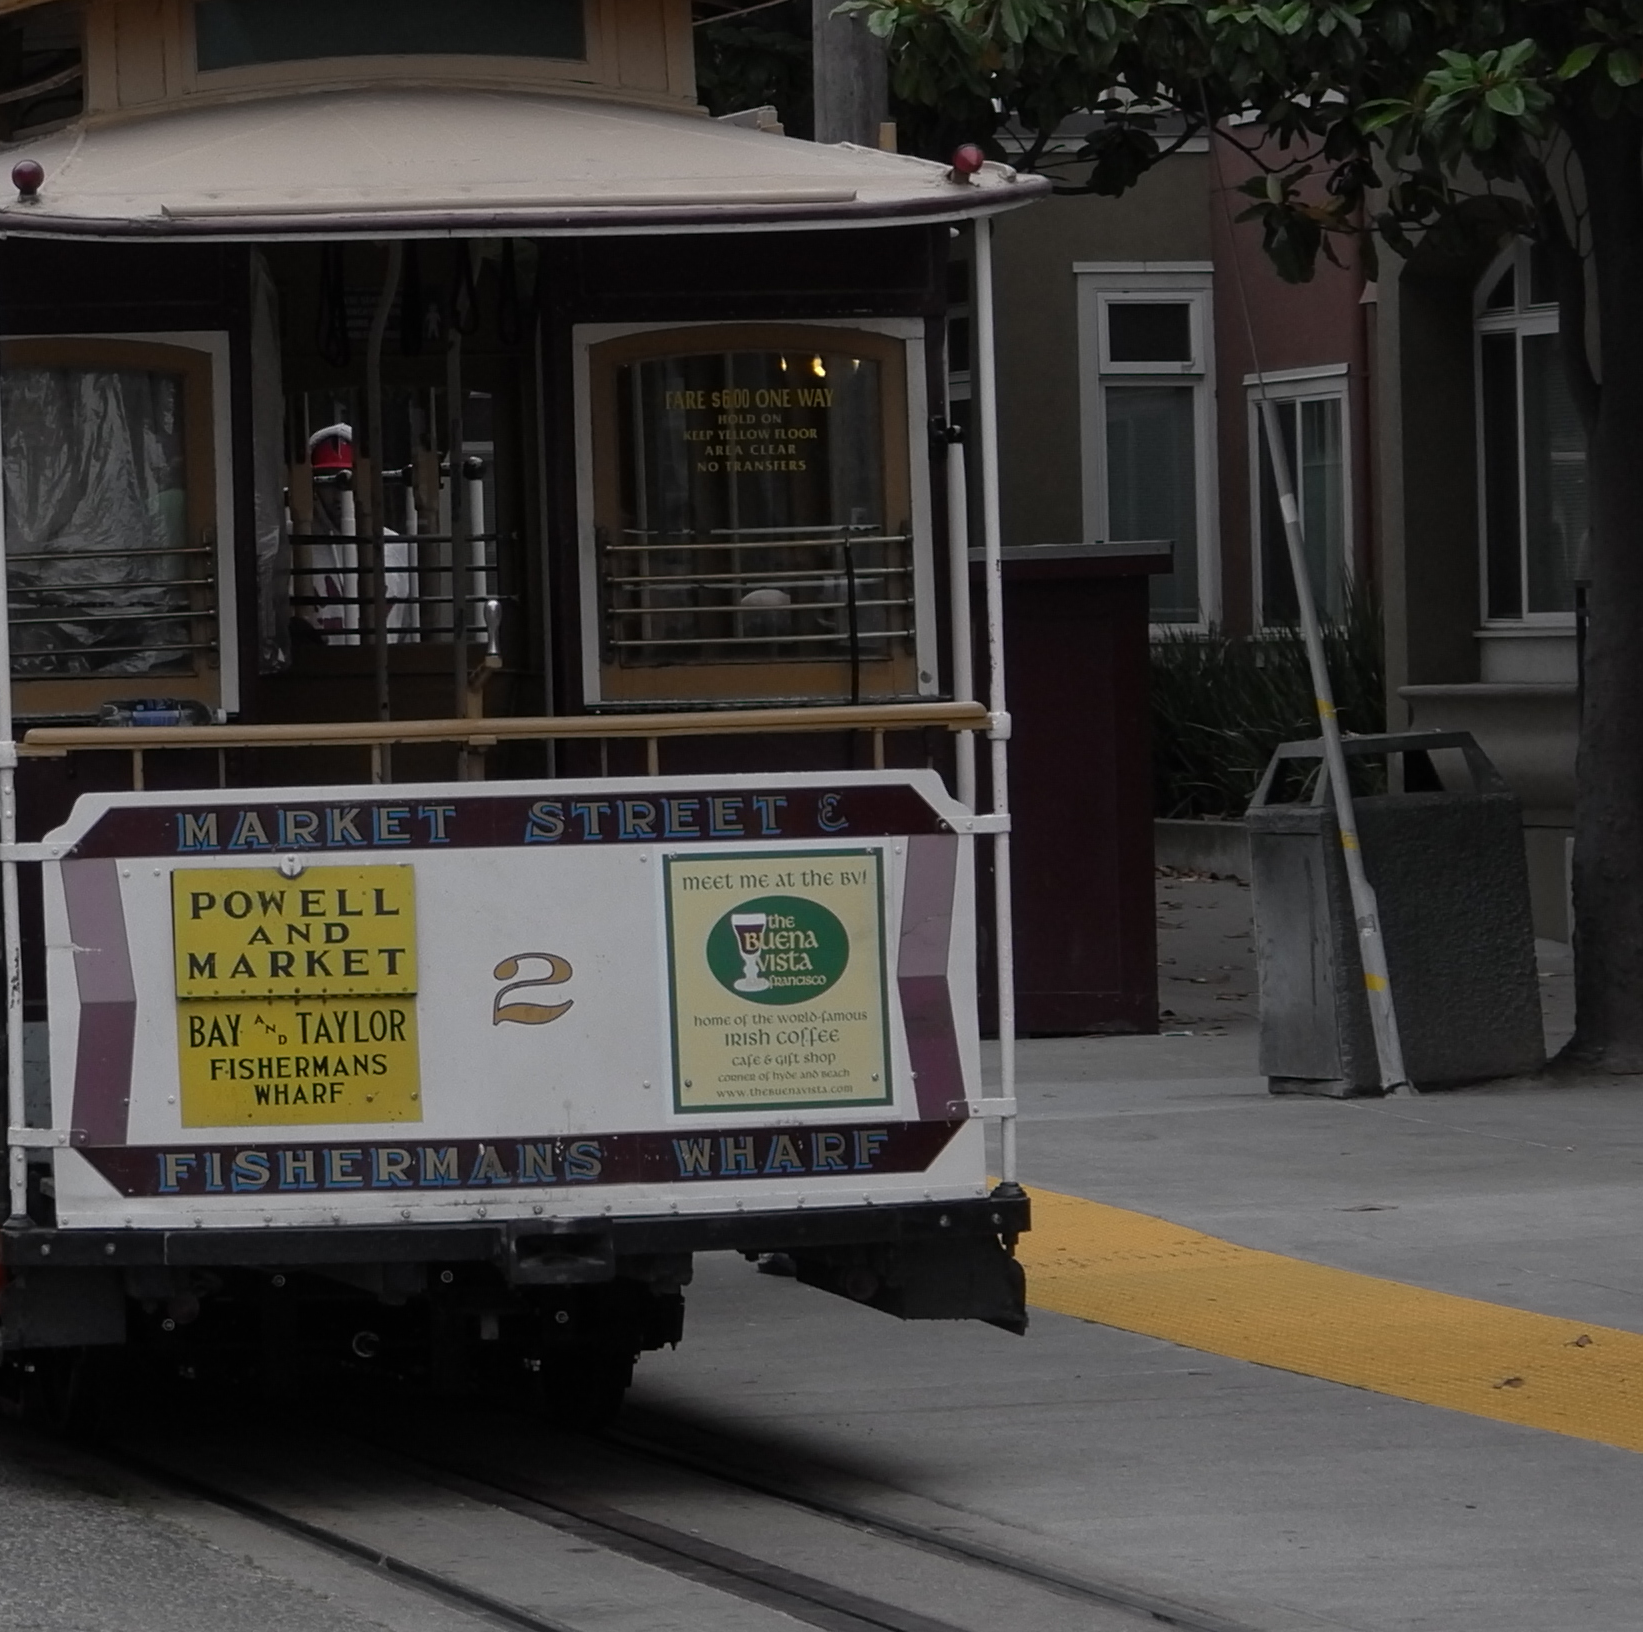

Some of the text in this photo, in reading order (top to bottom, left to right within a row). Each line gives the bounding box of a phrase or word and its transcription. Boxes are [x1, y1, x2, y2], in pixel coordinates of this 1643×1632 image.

[666, 391, 706, 409] FARE
[755, 389, 791, 408] ONE
[798, 388, 834, 407] WAY
[718, 414, 782, 425] HOLD ON
[683, 428, 818, 441] KEEP YELLOW FLOOR
[705, 444, 796, 456] AREA CLEAR
[697, 460, 807, 472] NO TRANSFERS
[175, 805, 457, 852] MARKET
[523, 797, 787, 844] STREET
[190, 889, 400, 920] POWELL
[247, 922, 350, 945] AND
[187, 948, 406, 980] MARKET
[493, 952, 574, 1026] 2
[189, 1009, 407, 1048] BAY AND TAYLOR
[210, 1054, 388, 1080] FISHERMANS
[254, 1082, 344, 1106] WHARF
[157, 1130, 890, 1192] FISHERMANS WHARF
